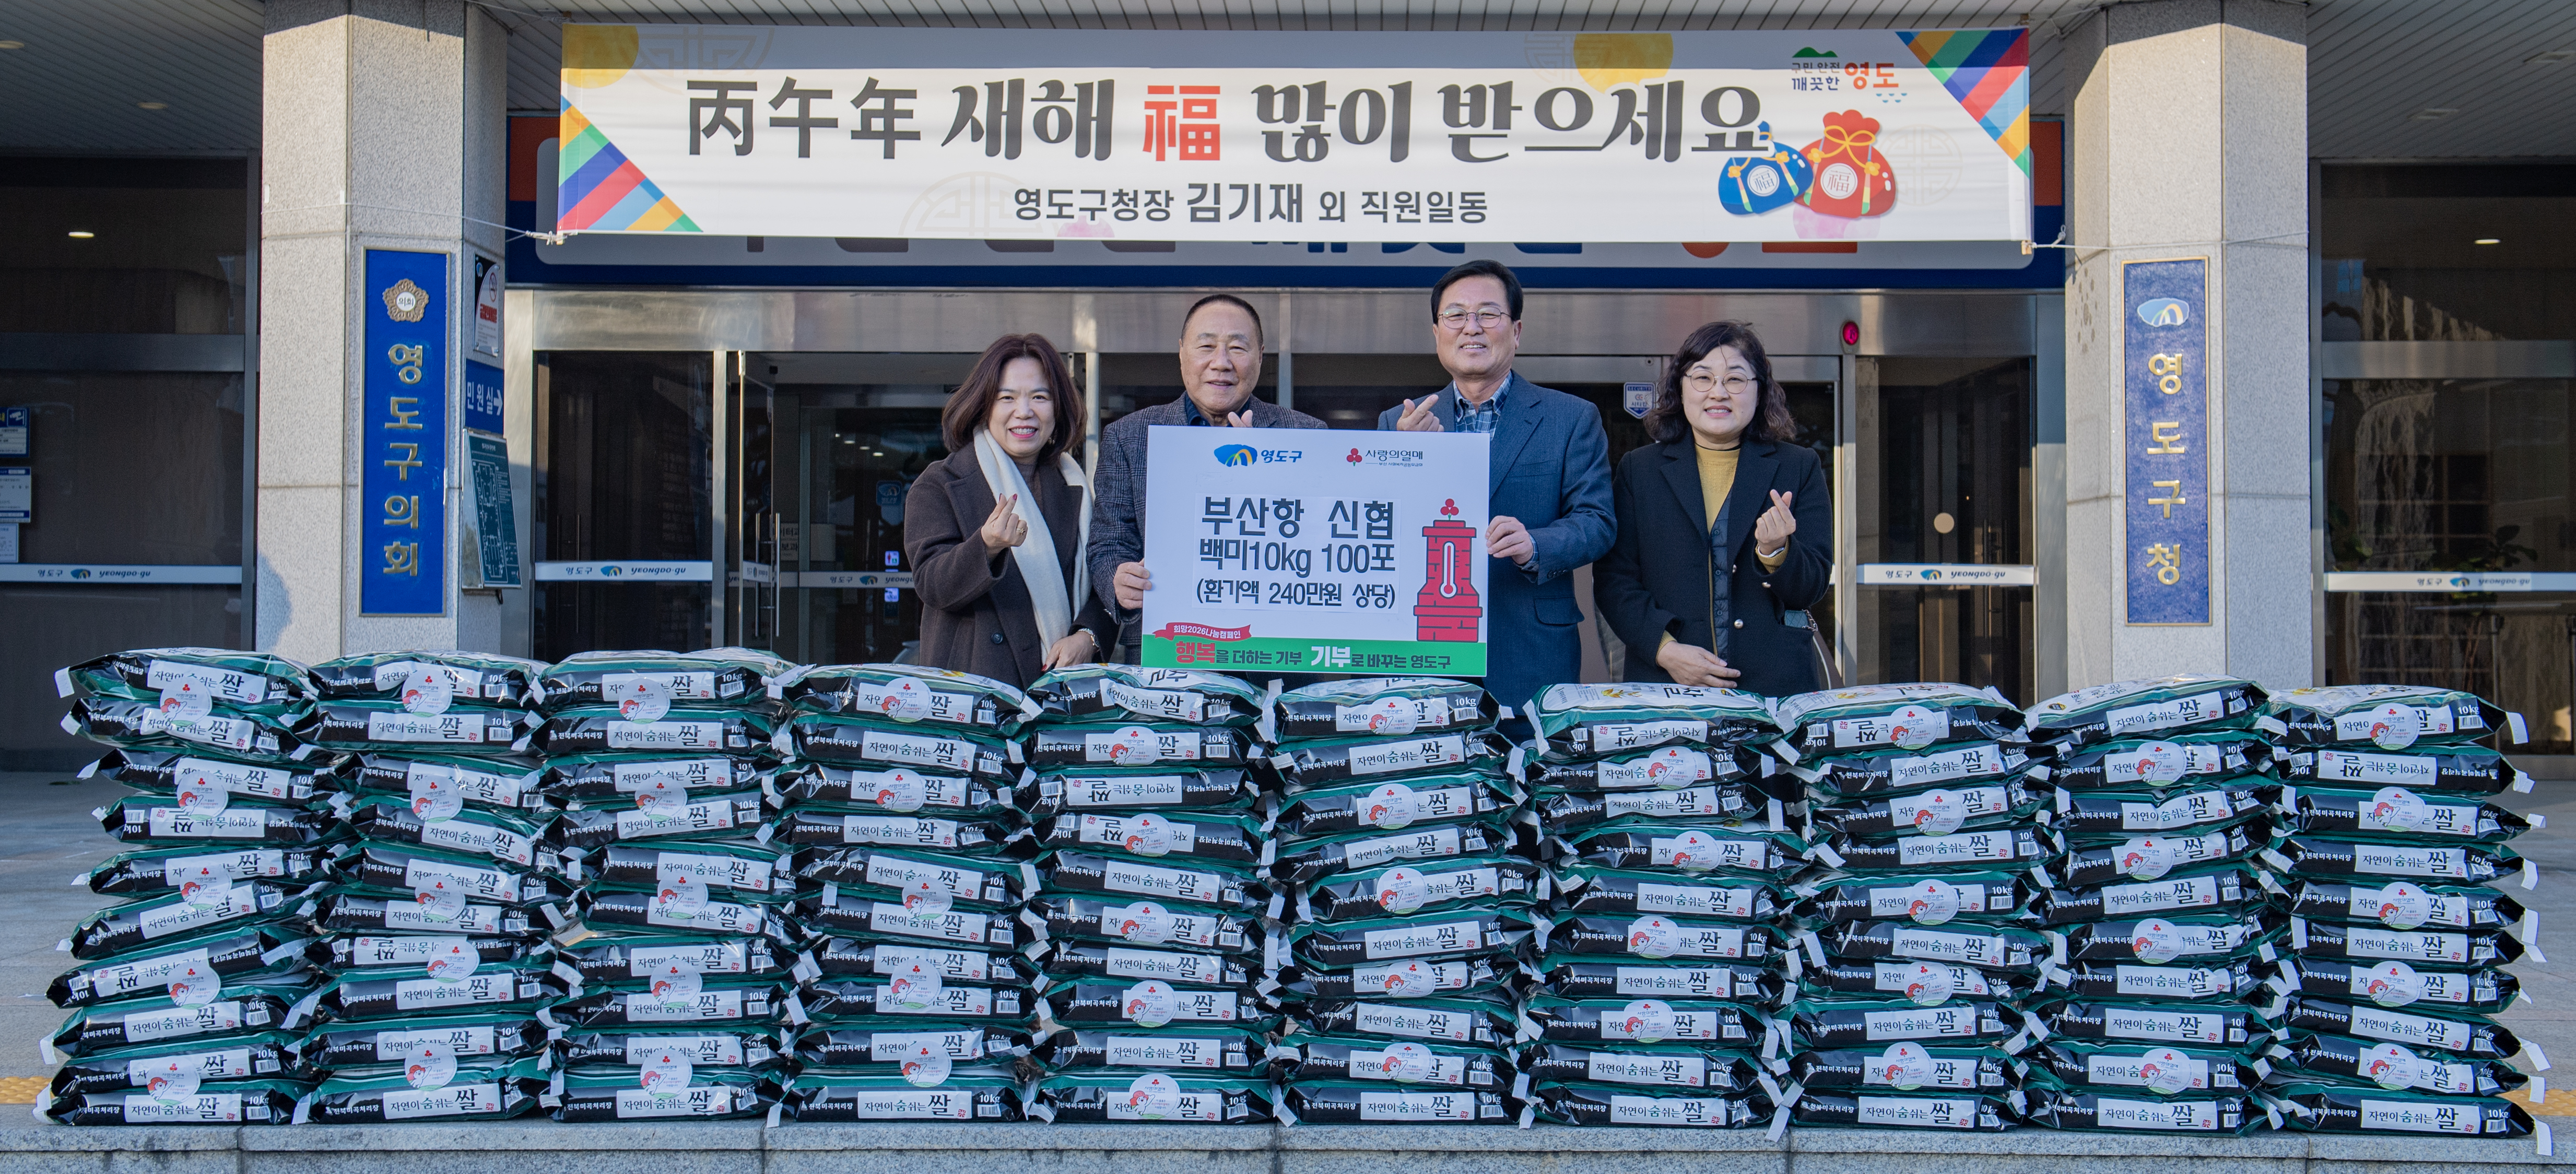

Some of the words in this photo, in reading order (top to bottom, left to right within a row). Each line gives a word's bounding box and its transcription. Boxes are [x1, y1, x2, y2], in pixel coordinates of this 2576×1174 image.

[1792, 77, 1840, 91] 깨끗한
[1844, 62, 1899, 90] 영도
[687, 76, 921, 160] 丙午年
[940, 78, 1114, 161] 새해
[1142, 85, 1221, 162] 福
[1251, 80, 1412, 163] 많이
[1437, 80, 1769, 163] 받으세요
[1827, 170, 1852, 193] 福
[1014, 188, 1174, 222] 영도구청장
[1187, 183, 1302, 223] 김기재
[1319, 191, 1345, 222] 외
[1361, 191, 1487, 223] 직원일동
[467, 382, 493, 415] 민원실
[384, 344, 423, 576] 영도구의회
[1261, 449, 1302, 464] 영도구
[1365, 449, 1423, 462] 사랑의열매
[2147, 353, 2186, 585] 영도구청
[1202, 496, 1304, 539] 부산항
[1327, 500, 1394, 540] 신협
[1199, 538, 1312, 578] 백미10kg
[1321, 543, 1395, 574] 100포
[1885, 570, 1912, 579] 영도구
[1196, 578, 1260, 604] (환가액
[1268, 582, 1342, 607] 240만원
[1352, 584, 1395, 609] 상당)
[1173, 624, 1241, 639] 희망2026나눔캠페인
[1175, 641, 1229, 663] 행복을
[1232, 649, 1272, 665] 더하는
[1276, 650, 1302, 666] 기부
[1311, 645, 1364, 668] 기부로
[1367, 653, 1407, 669] 바꾸는
[1410, 654, 1451, 670] 영도구
[722, 672, 743, 682] 10kg
[1455, 697, 1476, 707] 10kg
[2457, 706, 2479, 715] 10kg
[2116, 716, 2145, 729] 자연이
[2178, 699, 2206, 723] 쌀
[377, 722, 405, 733] 자연이
[438, 717, 465, 740] 쌀
[614, 731, 642, 742] 자연이
[677, 725, 705, 747] 쌀
[1208, 734, 1229, 744] 10kg
[868, 742, 898, 754] 자연이
[933, 742, 958, 767] 쌀
[1357, 754, 1385, 766] 자연이
[1419, 740, 1447, 764] 쌀
[1906, 844, 1934, 856] 자연이
[1969, 834, 1996, 858] 쌀
[994, 919, 1014, 930] 10kg
[1624, 977, 1652, 988] 자연이
[1687, 971, 1713, 994] 쌀
[248, 1001, 267, 1011] 10kg
[132, 1021, 161, 1034] 자연이
[195, 1006, 221, 1029] 쌀
[2359, 1017, 2389, 1031] 자연이
[2424, 1021, 2449, 1047] 쌀
[1113, 1047, 1142, 1058] 자연이
[1176, 1041, 1203, 1064] 쌀
[131, 1105, 160, 1116] 자연이
[195, 1097, 224, 1120] 쌀
[249, 1096, 269, 1105] 10kg
[391, 1100, 420, 1112] 자연이
[455, 1088, 483, 1111] 쌀
[624, 1099, 653, 1111] 자연이
[687, 1090, 714, 1113] 쌀
[864, 1101, 893, 1112] 자연이
[927, 1094, 955, 1117] 쌀
[979, 1094, 1000, 1104] 10kg
[1312, 1101, 1356, 1110] 전북미곡처리장
[1367, 1102, 1396, 1113] 자연이
[1430, 1095, 1457, 1118] 쌀
[1865, 1107, 1895, 1118] 자연이
[1930, 1102, 1956, 1125] 쌀
[2105, 1109, 2135, 1121] 자연이
[2171, 1104, 2199, 1127] 쌀
[2311, 1108, 2357, 1118] 전북미곡처리장
[2369, 1111, 2398, 1123] 자연이
[2434, 1107, 2462, 1131] 쌀
